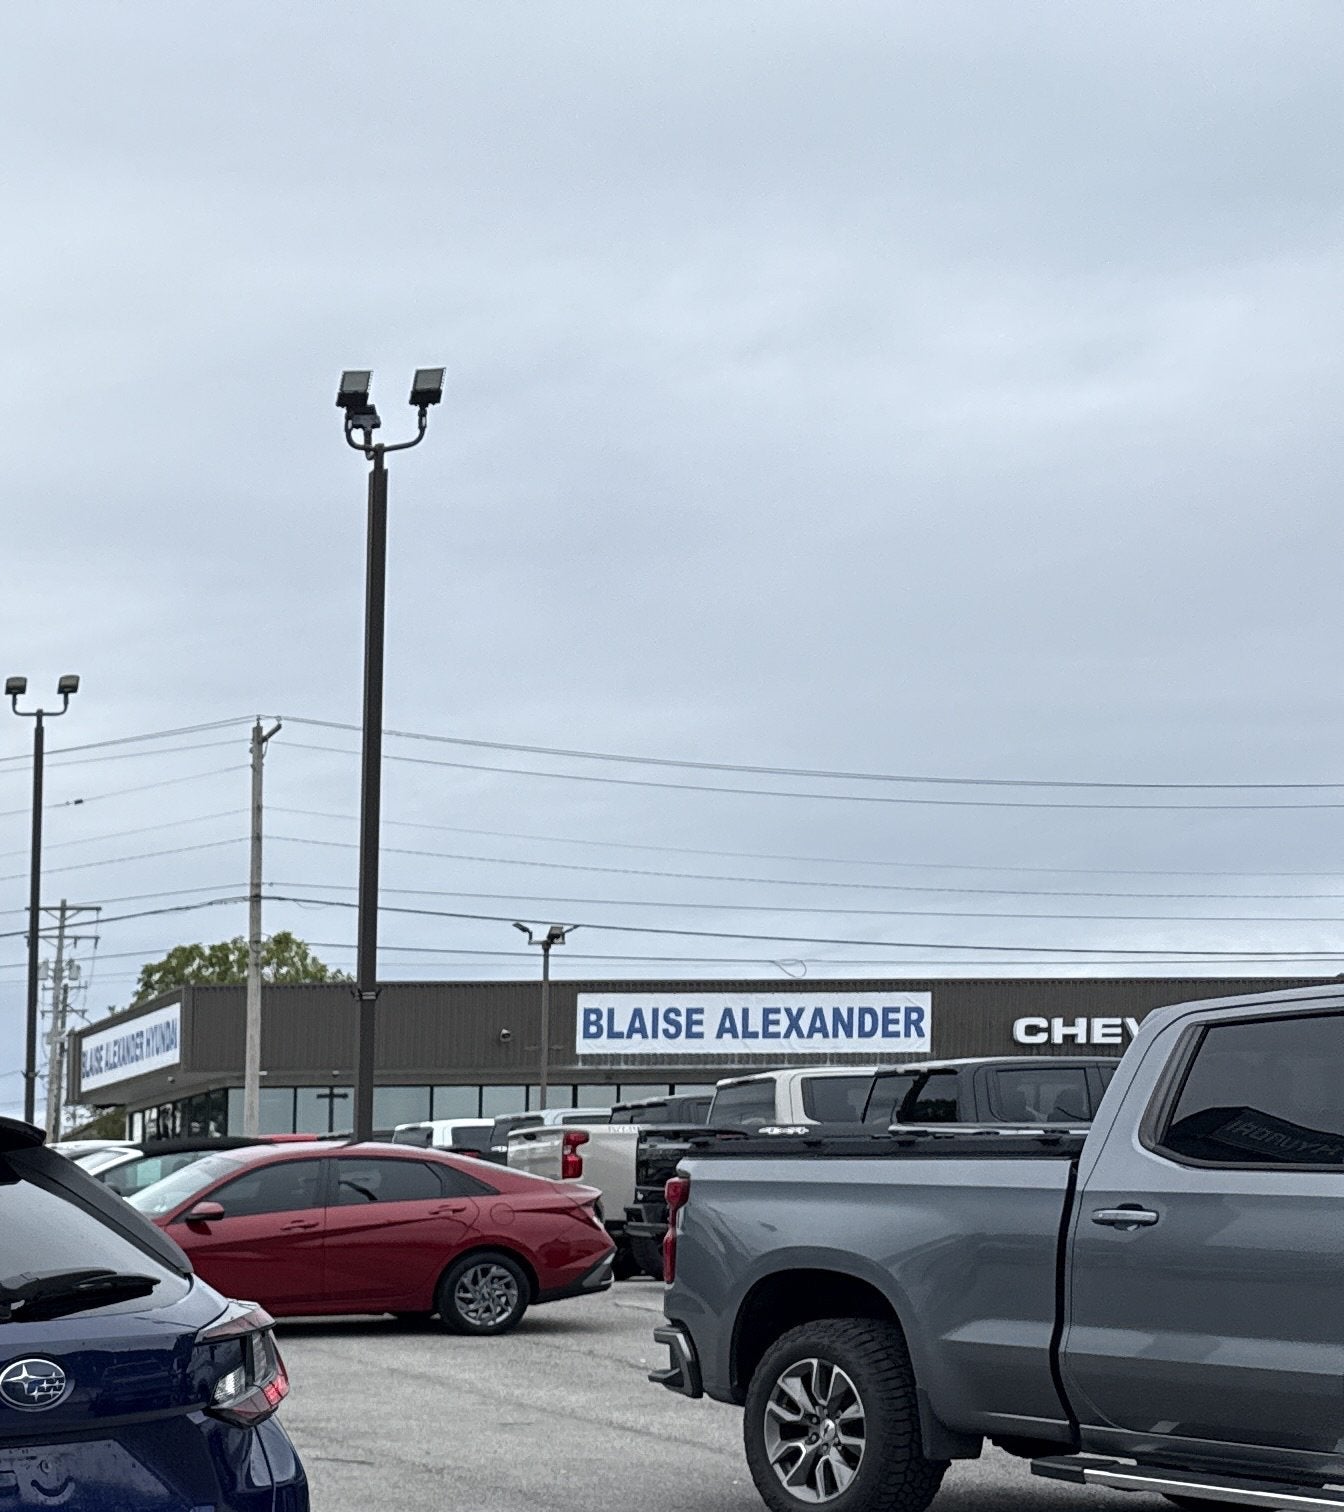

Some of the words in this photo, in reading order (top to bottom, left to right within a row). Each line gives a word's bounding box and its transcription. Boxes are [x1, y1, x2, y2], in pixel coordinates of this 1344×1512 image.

[105, 1030, 144, 1071] ALEXANDER
[145, 1017, 178, 1059] HYUNDAI
[582, 1007, 705, 1039] BLAISE
[715, 1006, 926, 1039] ALEXANDER
